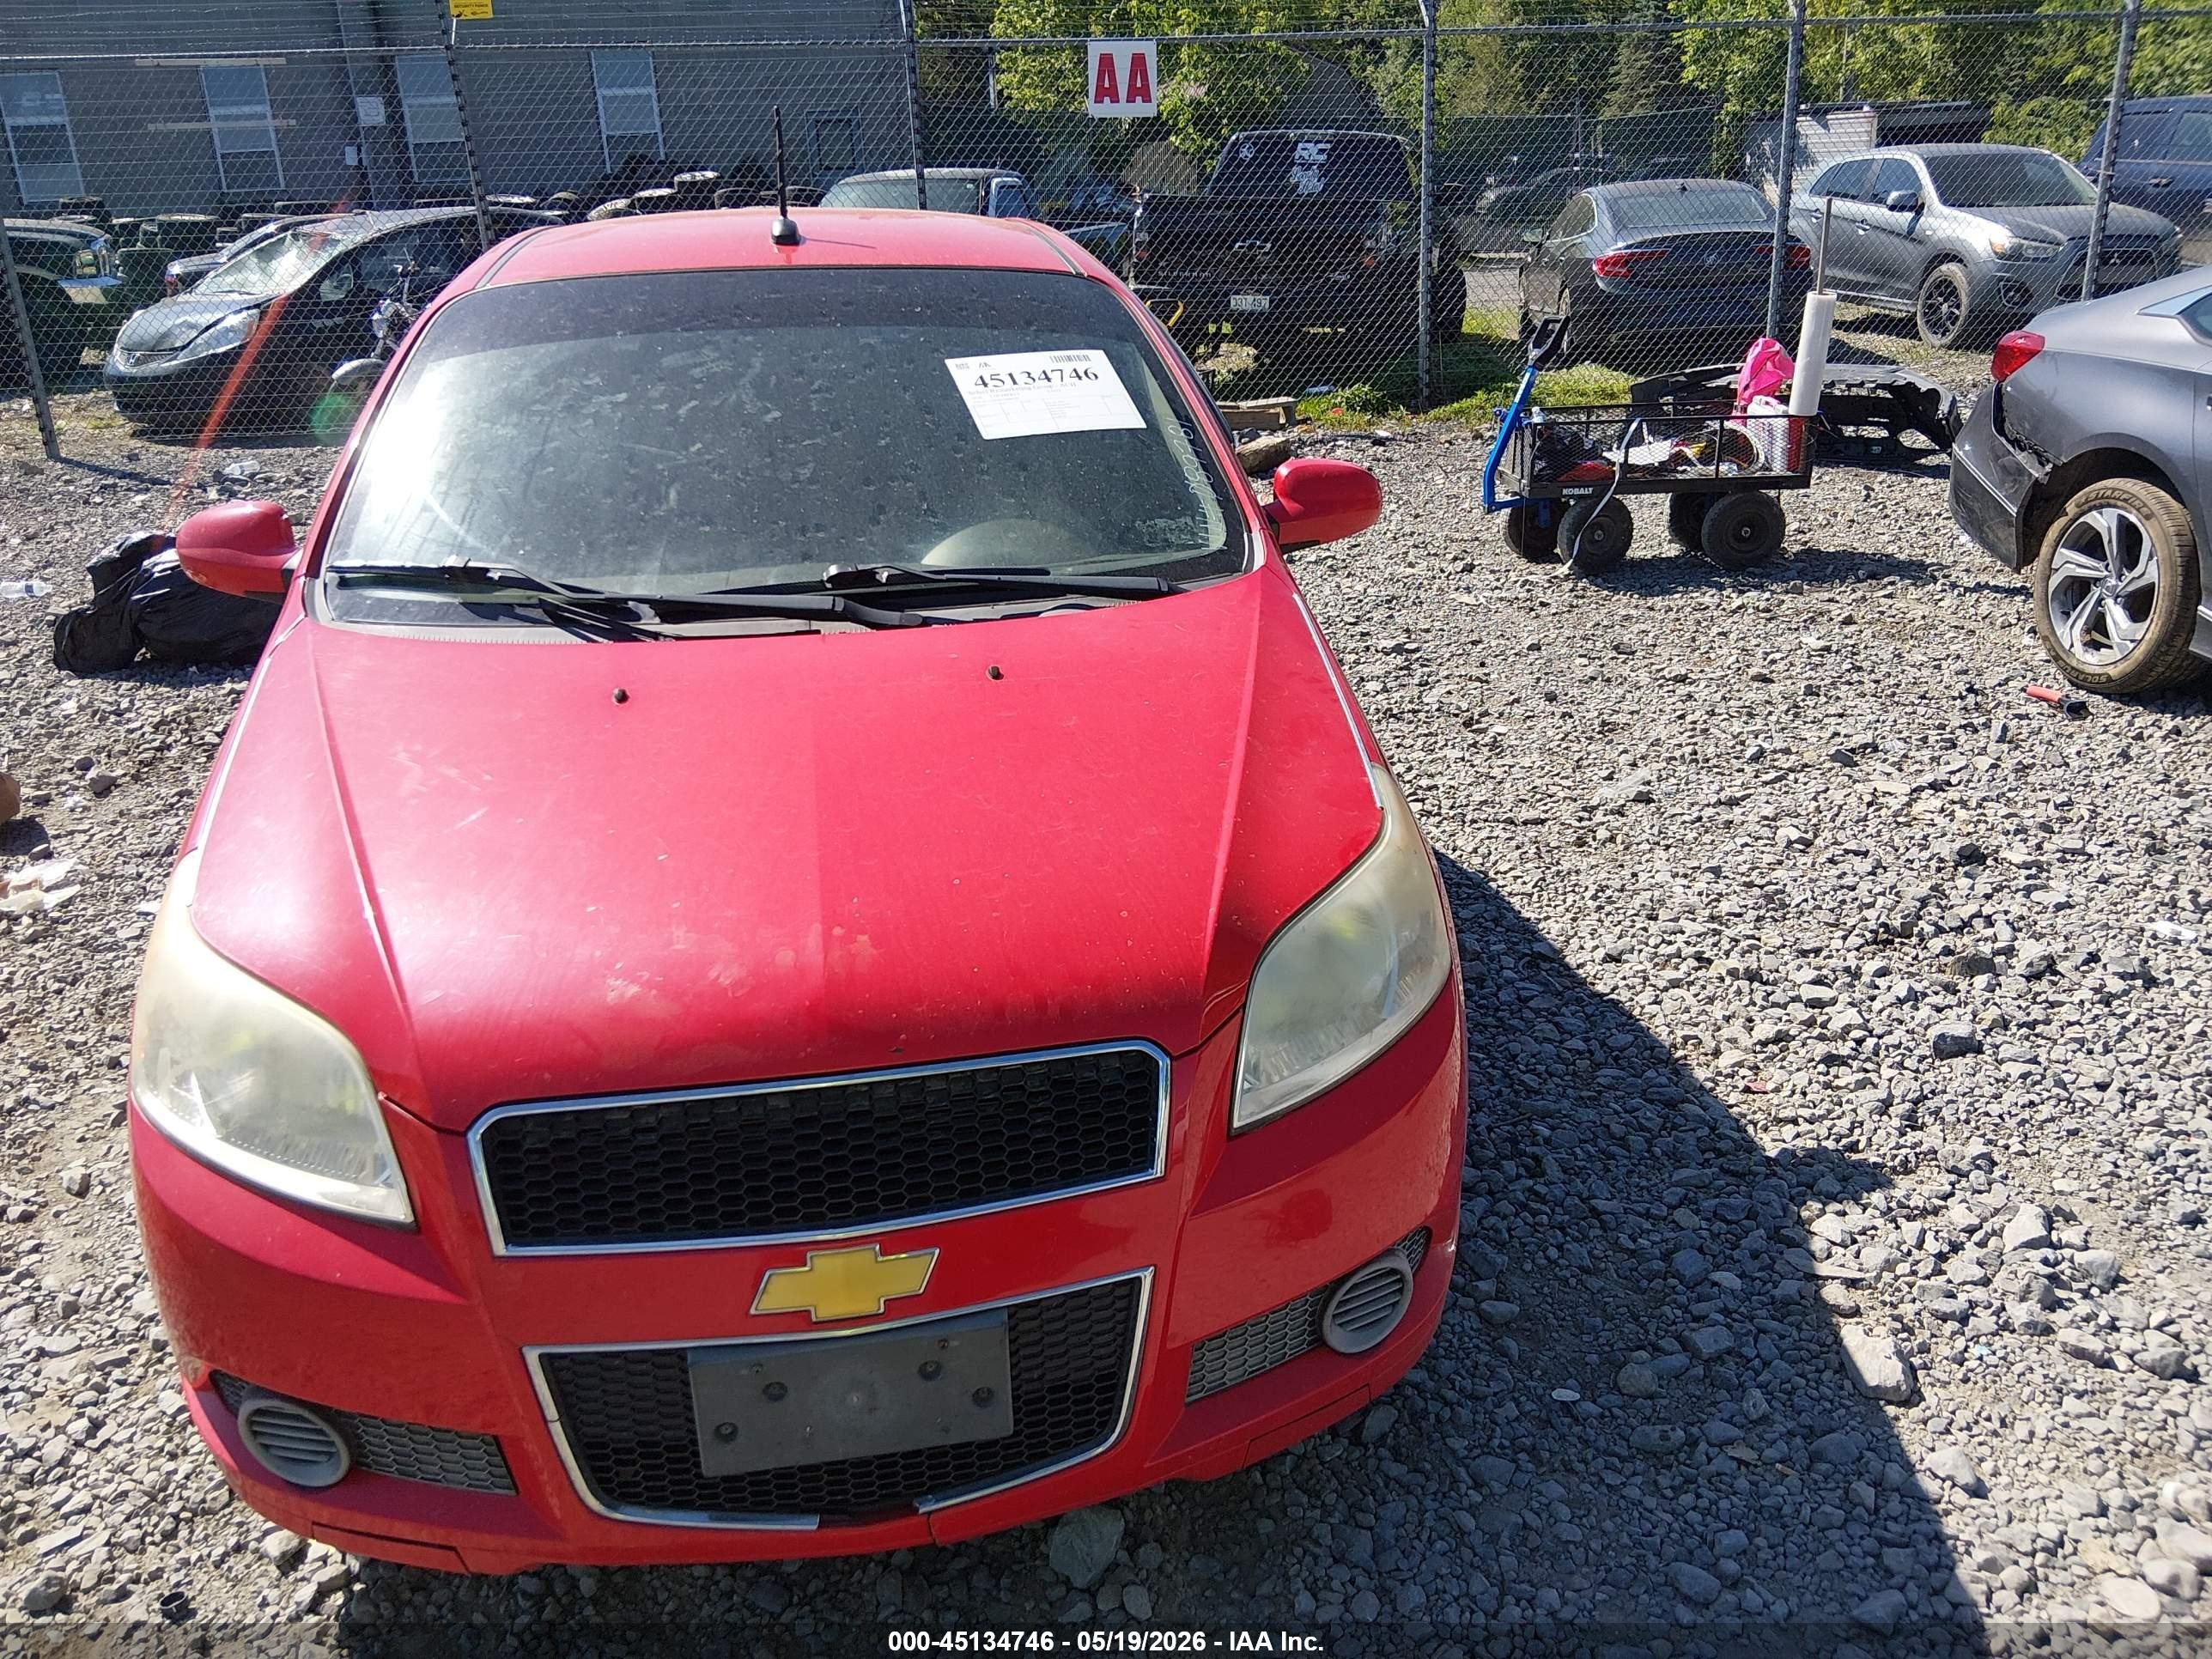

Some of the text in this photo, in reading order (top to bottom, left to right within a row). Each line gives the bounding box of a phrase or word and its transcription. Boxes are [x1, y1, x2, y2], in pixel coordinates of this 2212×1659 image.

[1094, 52, 1152, 104] AA
[974, 367, 1099, 389] 45134746
[1562, 487, 1594, 495] KOBALT
[2087, 489, 2152, 517] STARFIRE
[2057, 659, 2109, 684] SOLARUS
